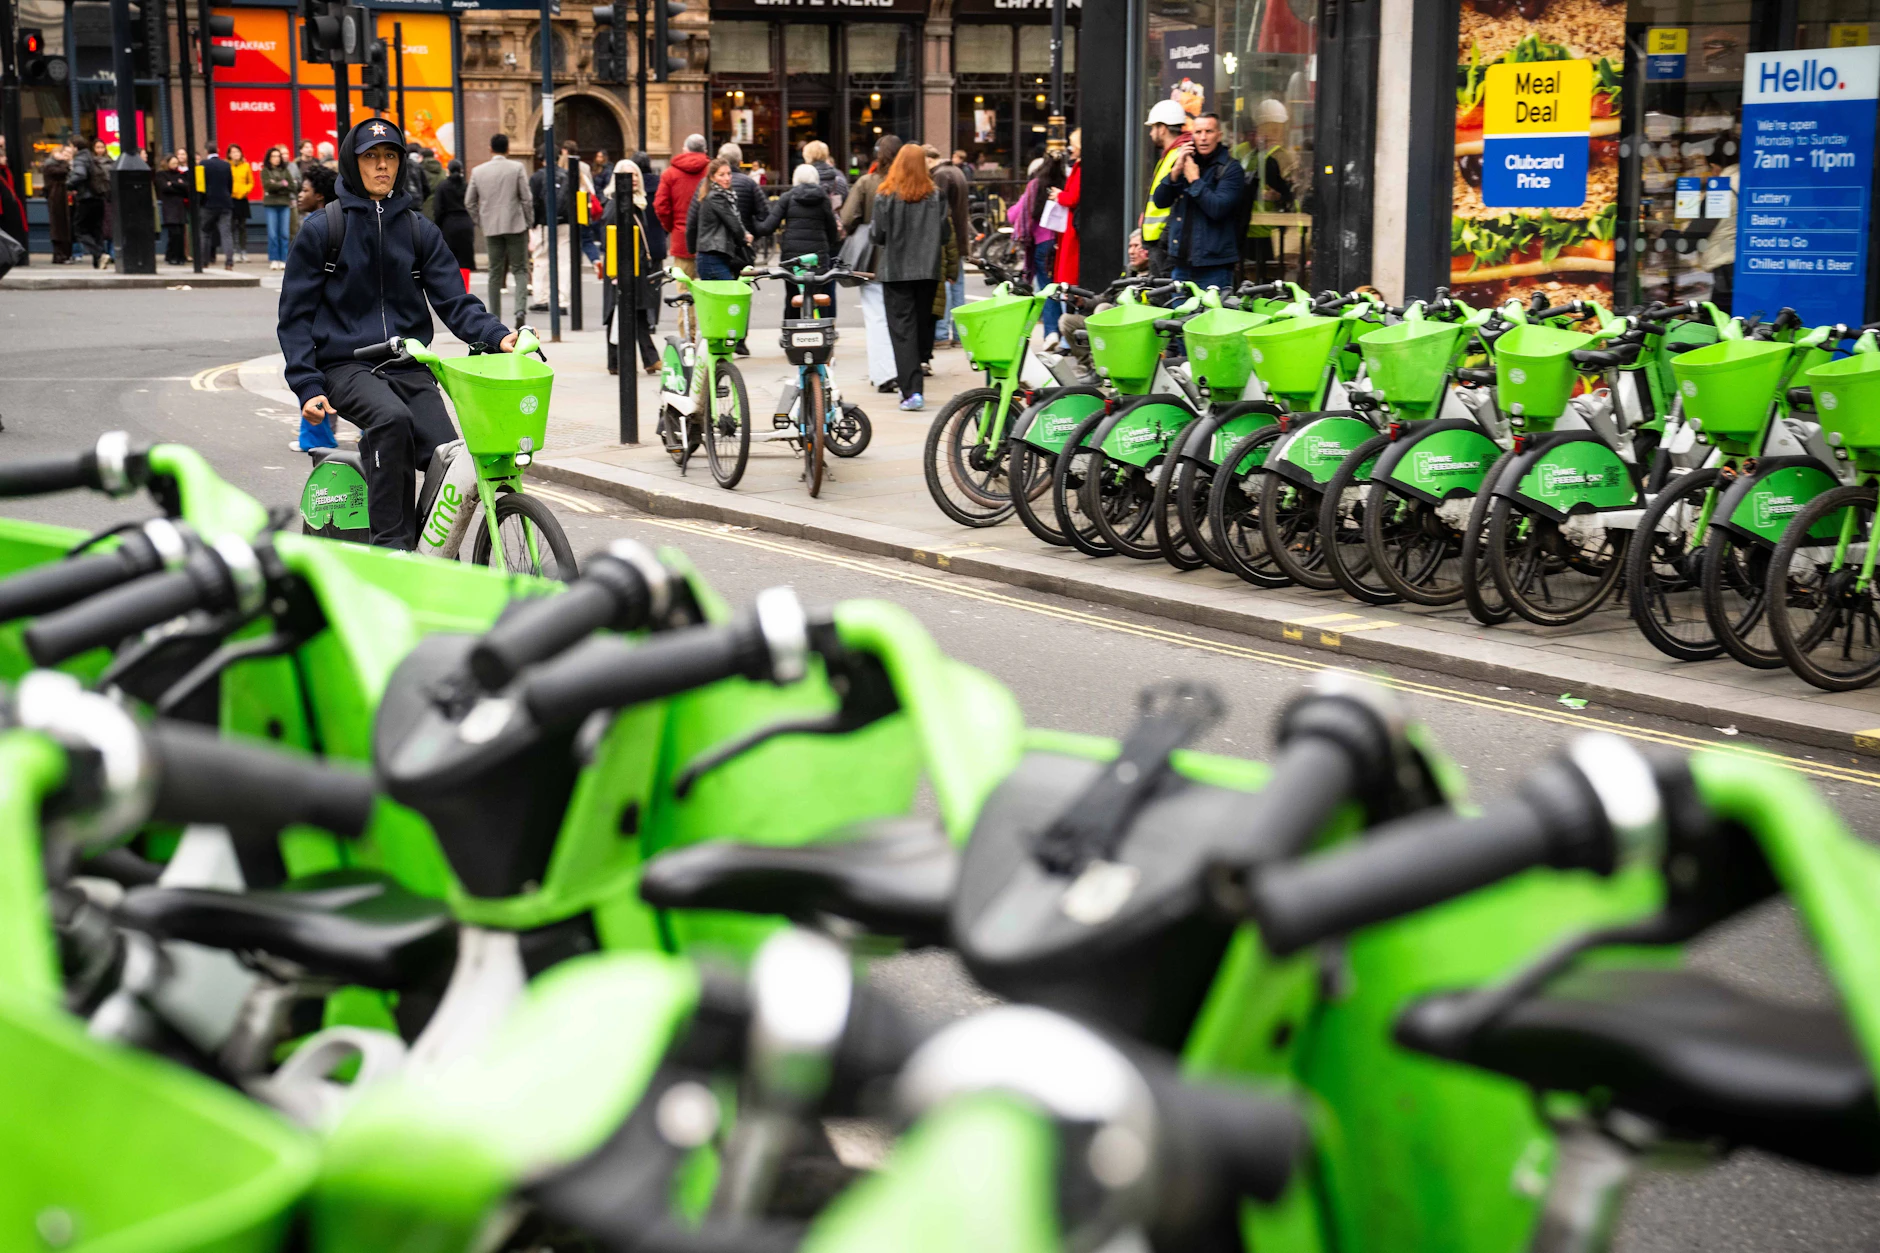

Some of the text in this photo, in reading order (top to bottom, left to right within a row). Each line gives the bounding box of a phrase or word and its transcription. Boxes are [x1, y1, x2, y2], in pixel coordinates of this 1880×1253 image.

[1516, 70, 1560, 95] Meal
[1759, 59, 1846, 93] Hello.
[230, 101, 276, 112] BURGERS
[319, 103, 355, 113] WRS
[1516, 100, 1558, 123] Deal
[1757, 120, 1818, 132] We're open
[1755, 133, 1849, 148] Monday to Sunday
[1504, 154, 1565, 170] Clubcard
[1753, 150, 1790, 168] 7am
[1810, 149, 1856, 172] 11pm
[1516, 173, 1552, 189] Price
[1752, 193, 1792, 206] Lottery
[1751, 214, 1788, 228] Bakery
[1750, 236, 1809, 248] Food to Go
[1748, 258, 1855, 271] Chilled Wine & Beer
[1428, 455, 1452, 463] HAVE
[1428, 461, 1480, 471] FEEDBACK?
[1552, 468, 1577, 476] HAVE
[315, 488, 328, 497] HAVE
[316, 494, 348, 505] FEEDBACK?
[1768, 496, 1794, 505] HAVE
[422, 486, 463, 547] Lime
